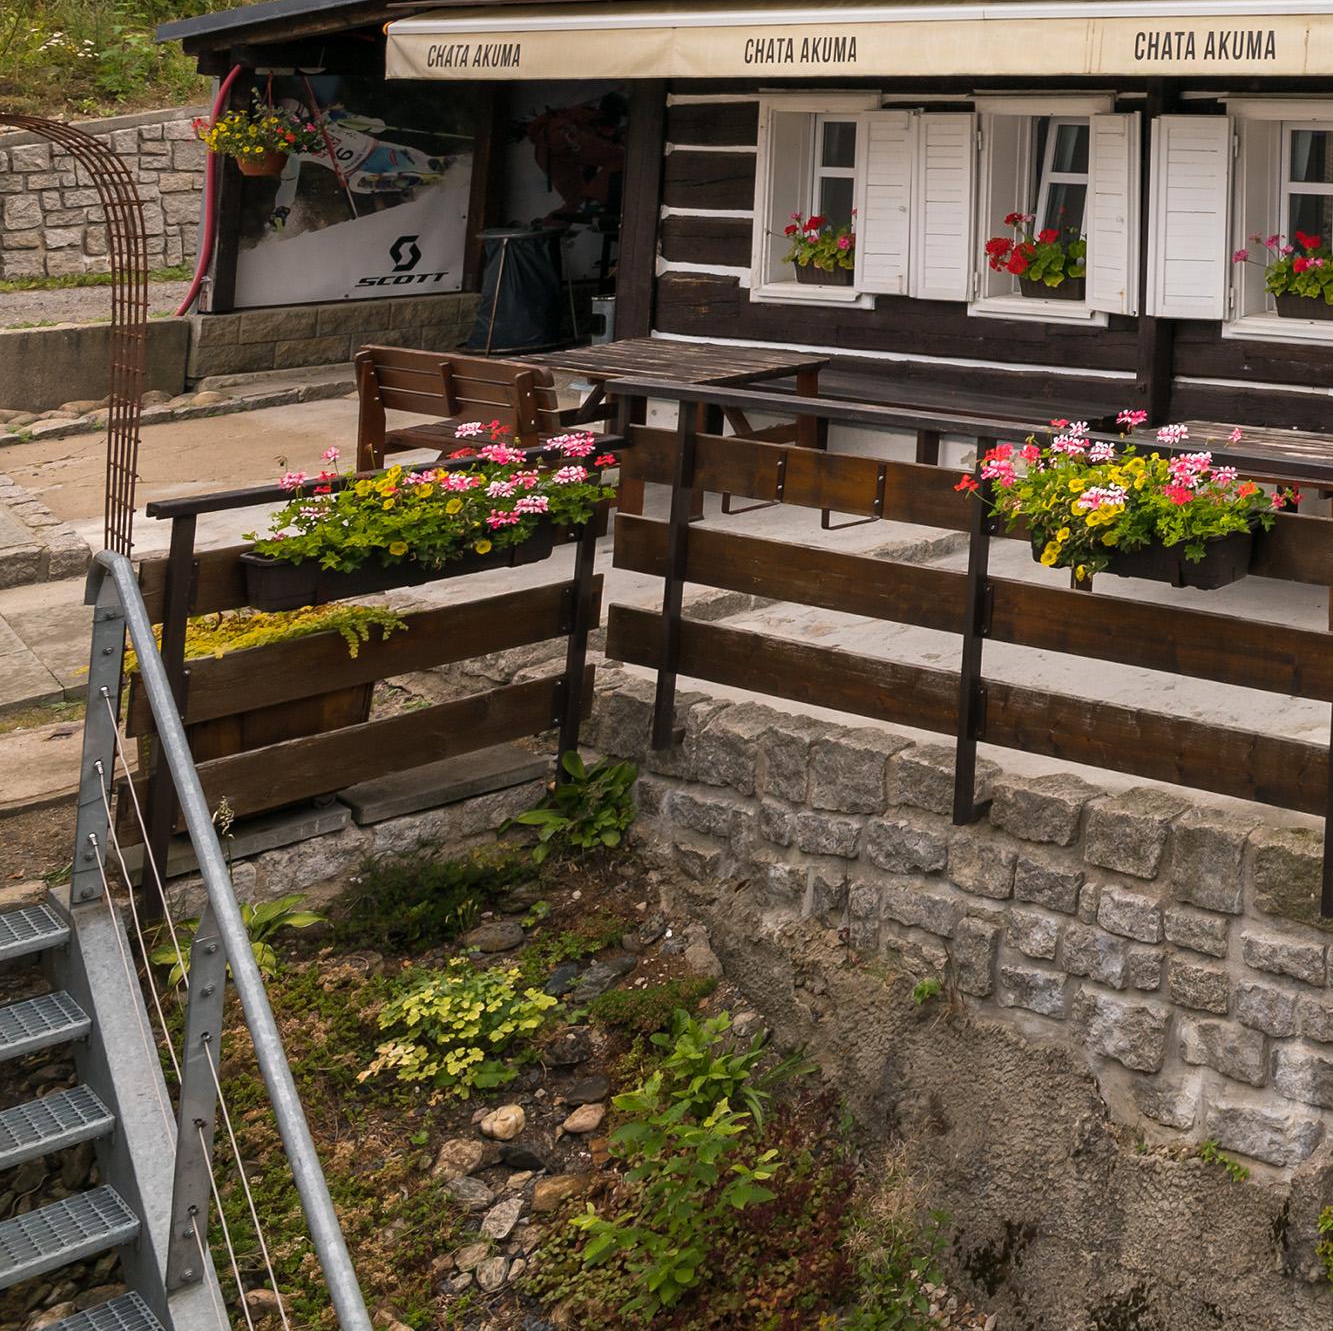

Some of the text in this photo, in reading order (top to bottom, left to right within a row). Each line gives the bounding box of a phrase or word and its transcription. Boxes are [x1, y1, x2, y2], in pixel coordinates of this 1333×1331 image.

[426, 43, 522, 68] CHATA AKUMA
[743, 36, 858, 65] CHATA AKUMA
[1133, 30, 1278, 61] CHATA AKUMA
[354, 271, 450, 288] SCOTT
